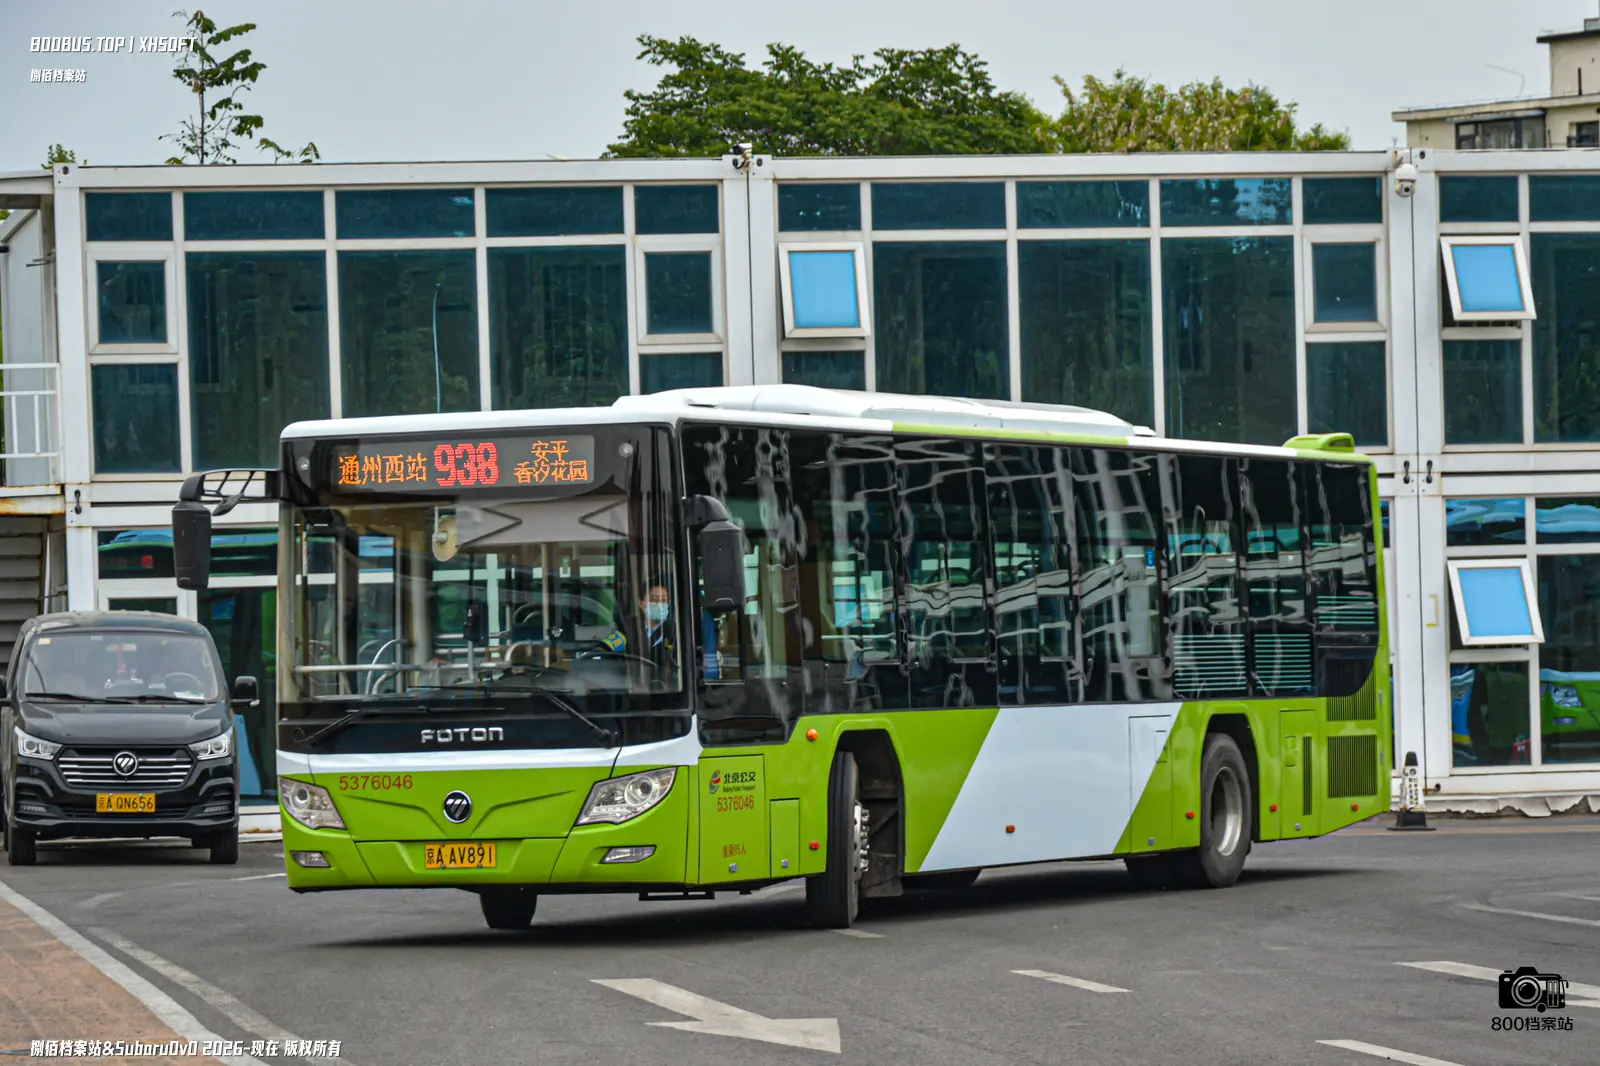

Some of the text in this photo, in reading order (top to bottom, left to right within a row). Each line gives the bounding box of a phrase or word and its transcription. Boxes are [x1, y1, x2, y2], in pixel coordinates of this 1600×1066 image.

[531, 440, 569, 463] 安平
[338, 442, 500, 487] 通州西站 938
[513, 459, 588, 484] 香汐花园
[421, 727, 504, 744] FOTON
[339, 775, 413, 791] 5376046
[723, 771, 756, 785] 北京公交
[717, 794, 755, 812] 5376046
